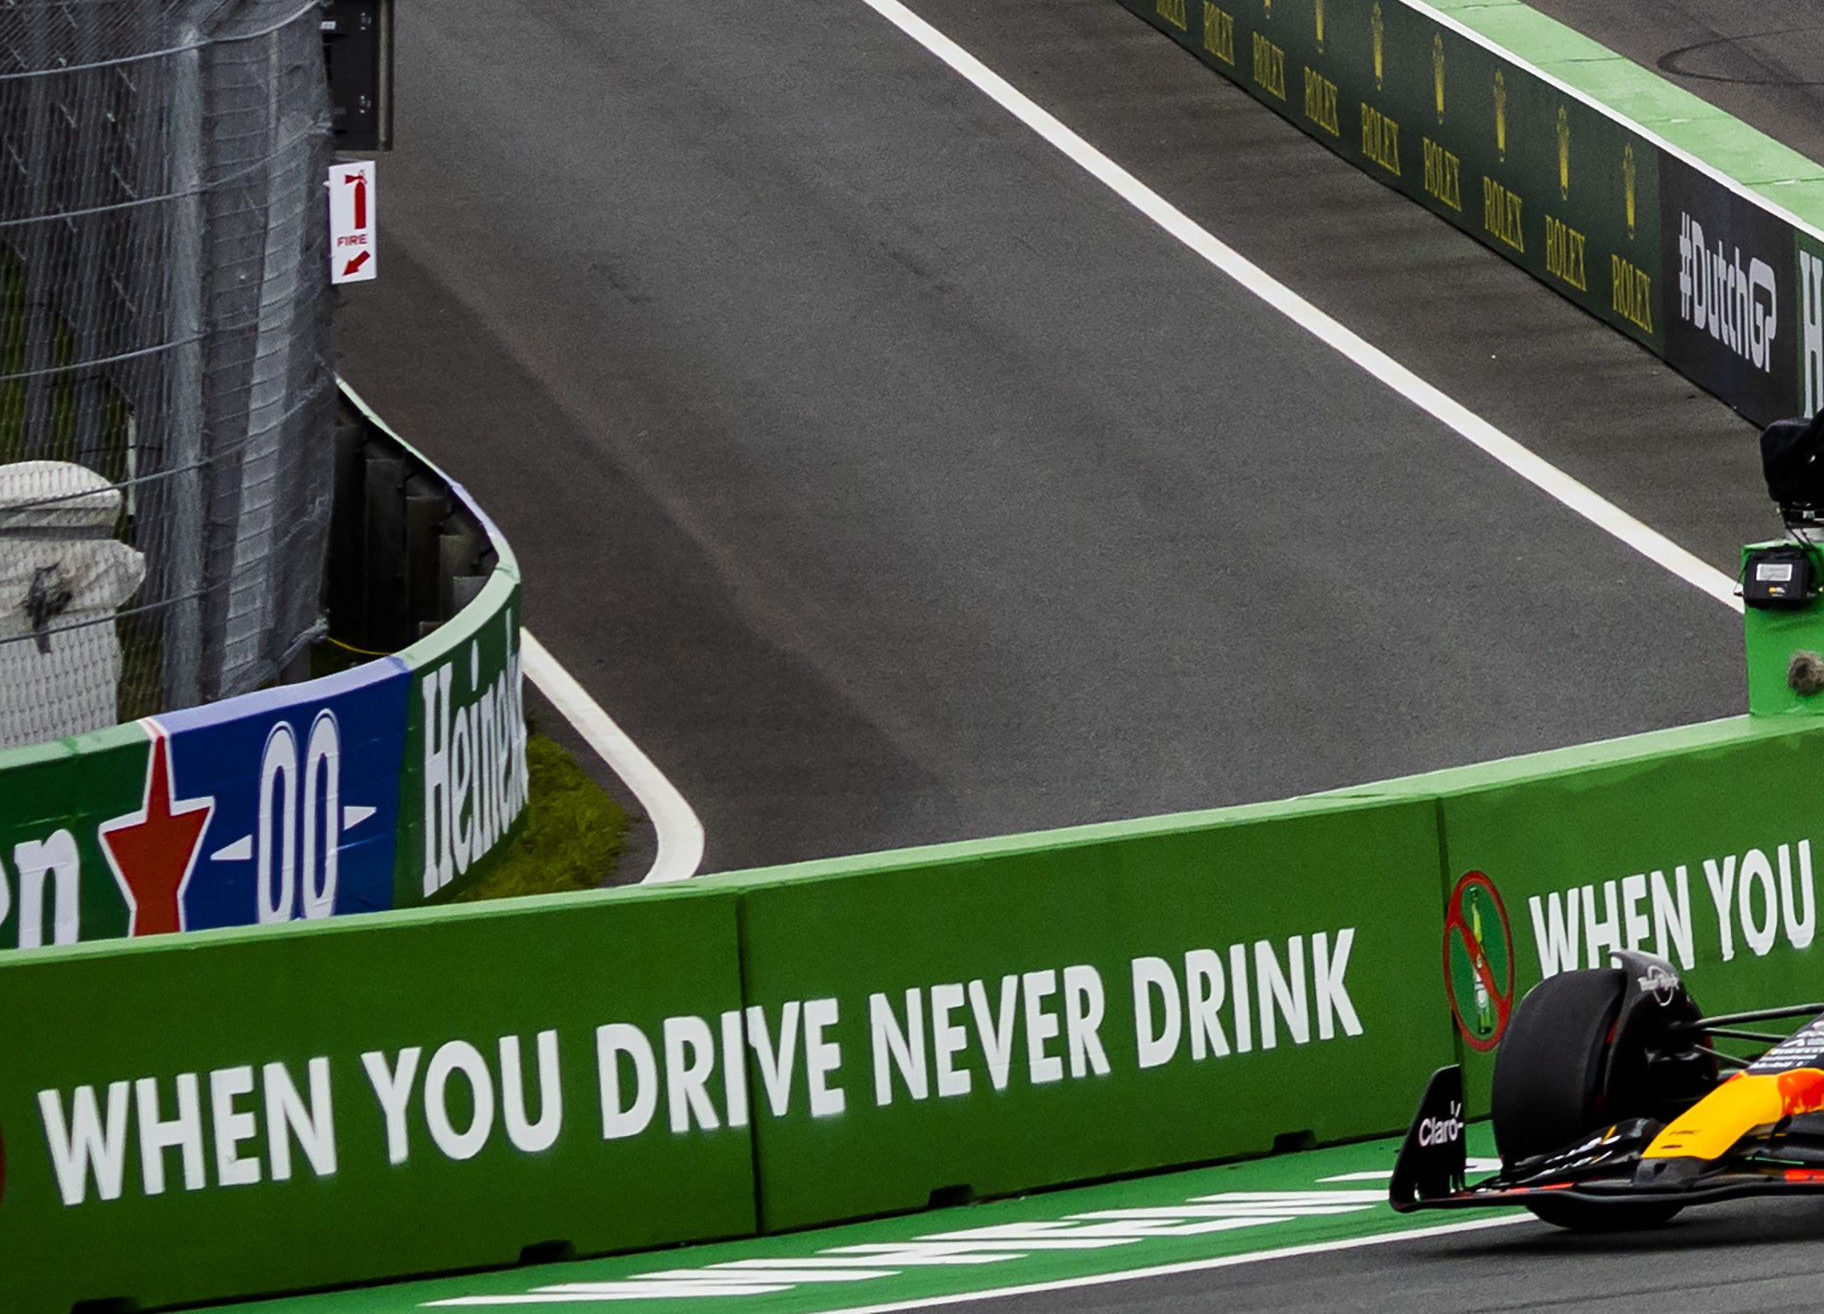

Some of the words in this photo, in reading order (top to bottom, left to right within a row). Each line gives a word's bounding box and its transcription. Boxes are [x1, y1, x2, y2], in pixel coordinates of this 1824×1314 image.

[1423, 137, 1462, 213] ROLEX
[337, 233, 368, 248] FIRE
[1483, 175, 1525, 254] ROLEX
[1545, 215, 1587, 293] ROLEX
[1611, 253, 1653, 335] ROLEX
[1528, 865, 1695, 980] WHEN
[1703, 839, 1817, 962] YOU
[38, 1057, 337, 1206] WHEN
[360, 1029, 564, 1166] YOU
[596, 997, 846, 1140] DRIVE
[869, 965, 1111, 1106] NEVER
[1130, 928, 1363, 1069] DRINK
[1419, 1116, 1460, 1148] Claro
